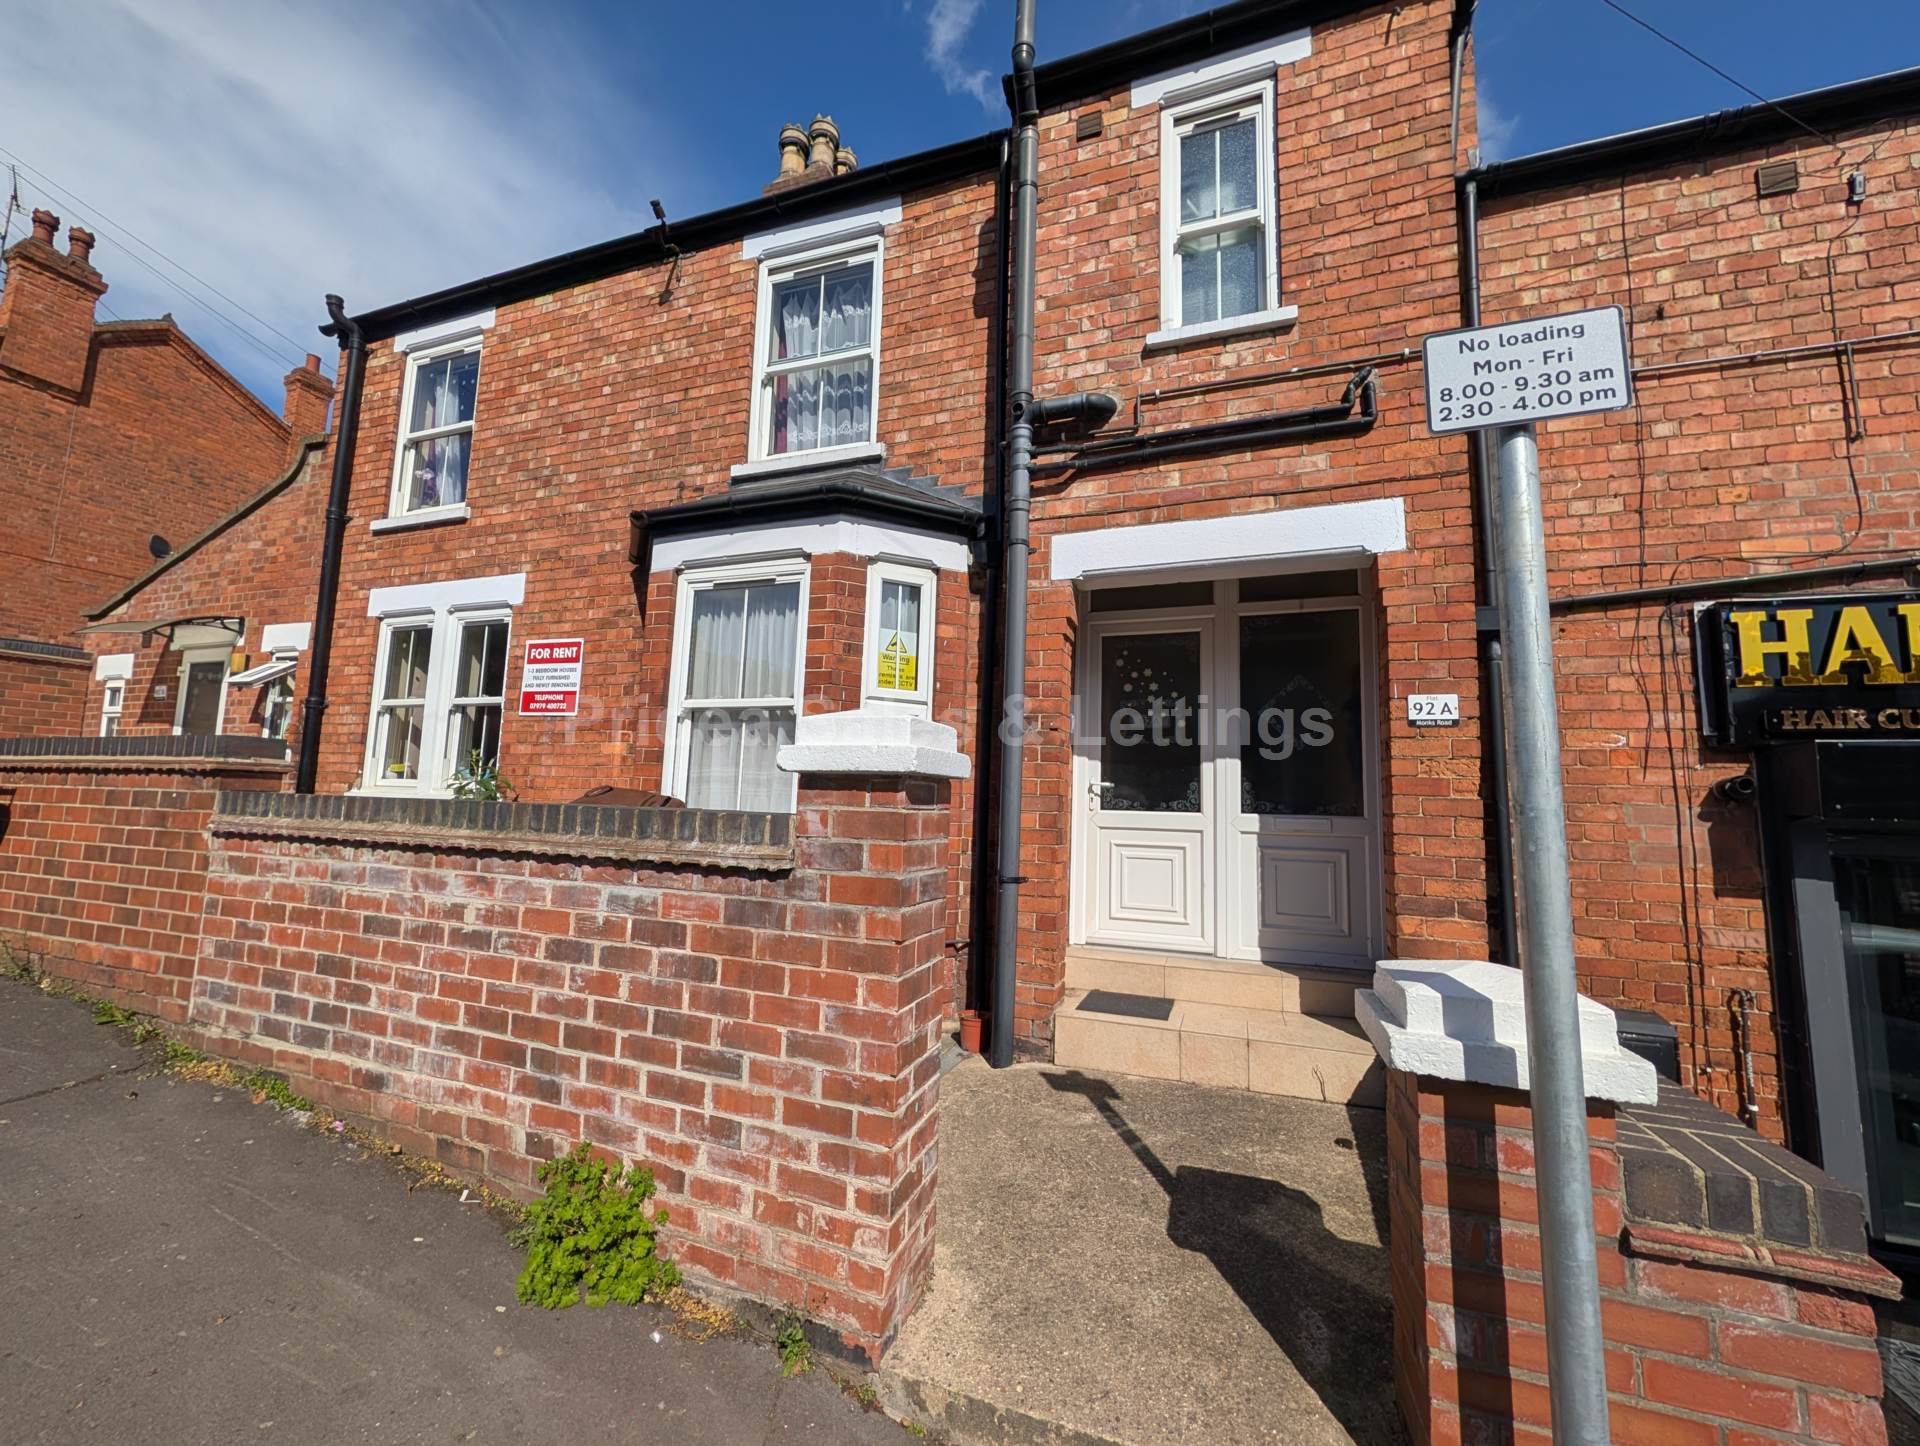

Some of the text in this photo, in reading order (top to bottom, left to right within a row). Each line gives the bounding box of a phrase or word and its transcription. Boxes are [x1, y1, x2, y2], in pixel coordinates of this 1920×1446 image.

[1458, 324, 1585, 354] No loading
[1473, 358, 1522, 376] Mon
[1543, 347, 1574, 365] Fri
[1439, 381, 1495, 403] 8.00
[1514, 370, 1571, 391] 9.30
[1578, 367, 1615, 382] am
[1439, 401, 1493, 422] 2.30
[1513, 389, 1572, 410] 4.00
[1579, 387, 1617, 405] pm
[530, 647, 578, 659] FOR RENT
[882, 653, 910, 663] Waring
[1781, 708, 1871, 730] HAIR
